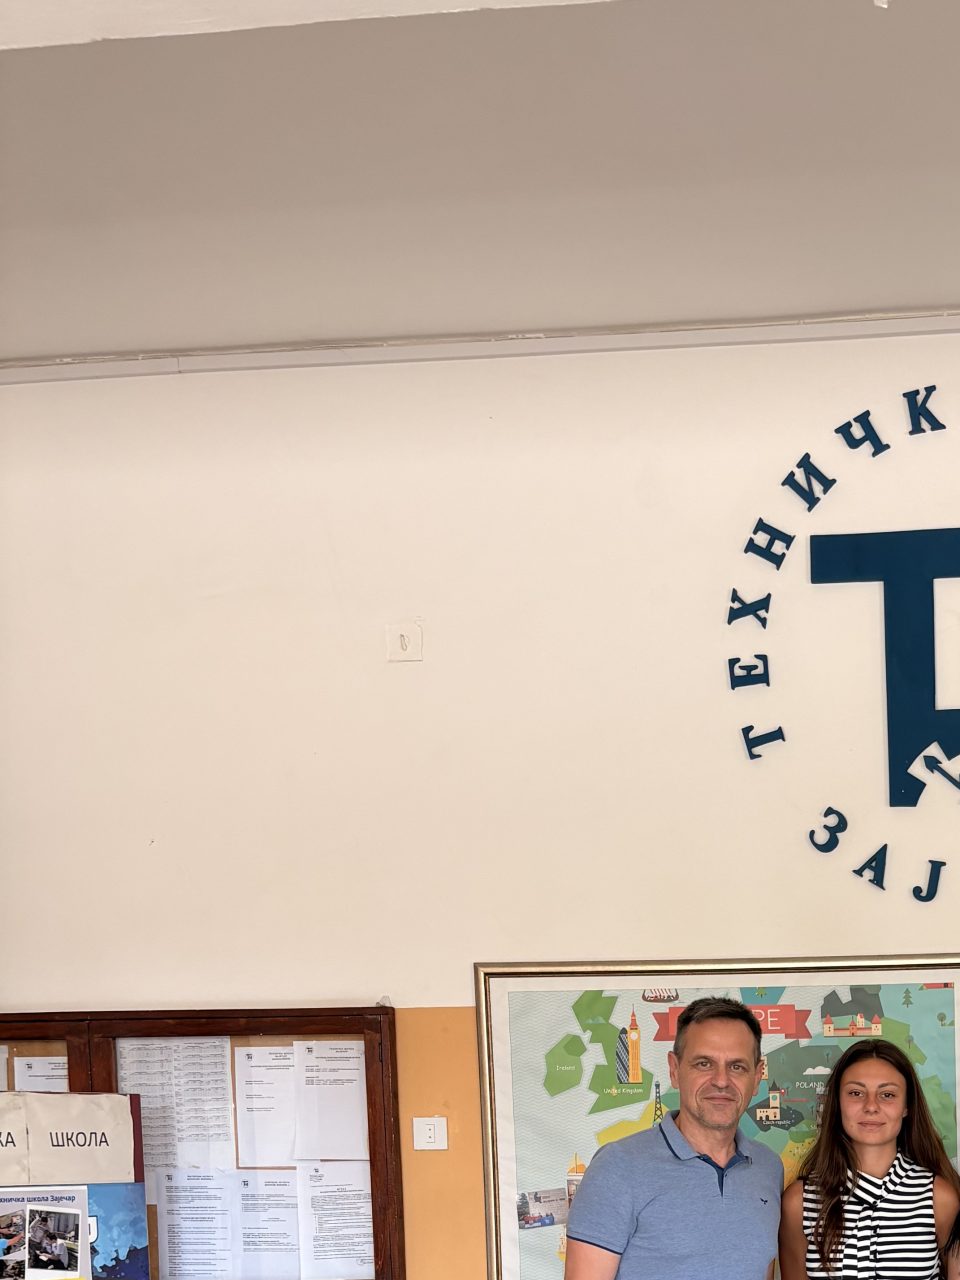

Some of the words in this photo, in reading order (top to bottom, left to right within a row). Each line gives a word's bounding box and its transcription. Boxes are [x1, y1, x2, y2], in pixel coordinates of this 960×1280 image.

[795, 1081, 825, 1089] POLAND
[48, 1131, 110, 1148] ШКОЛА
[26, 1195, 49, 1203] школа
[49, 1194, 76, 1204] Зајечар
